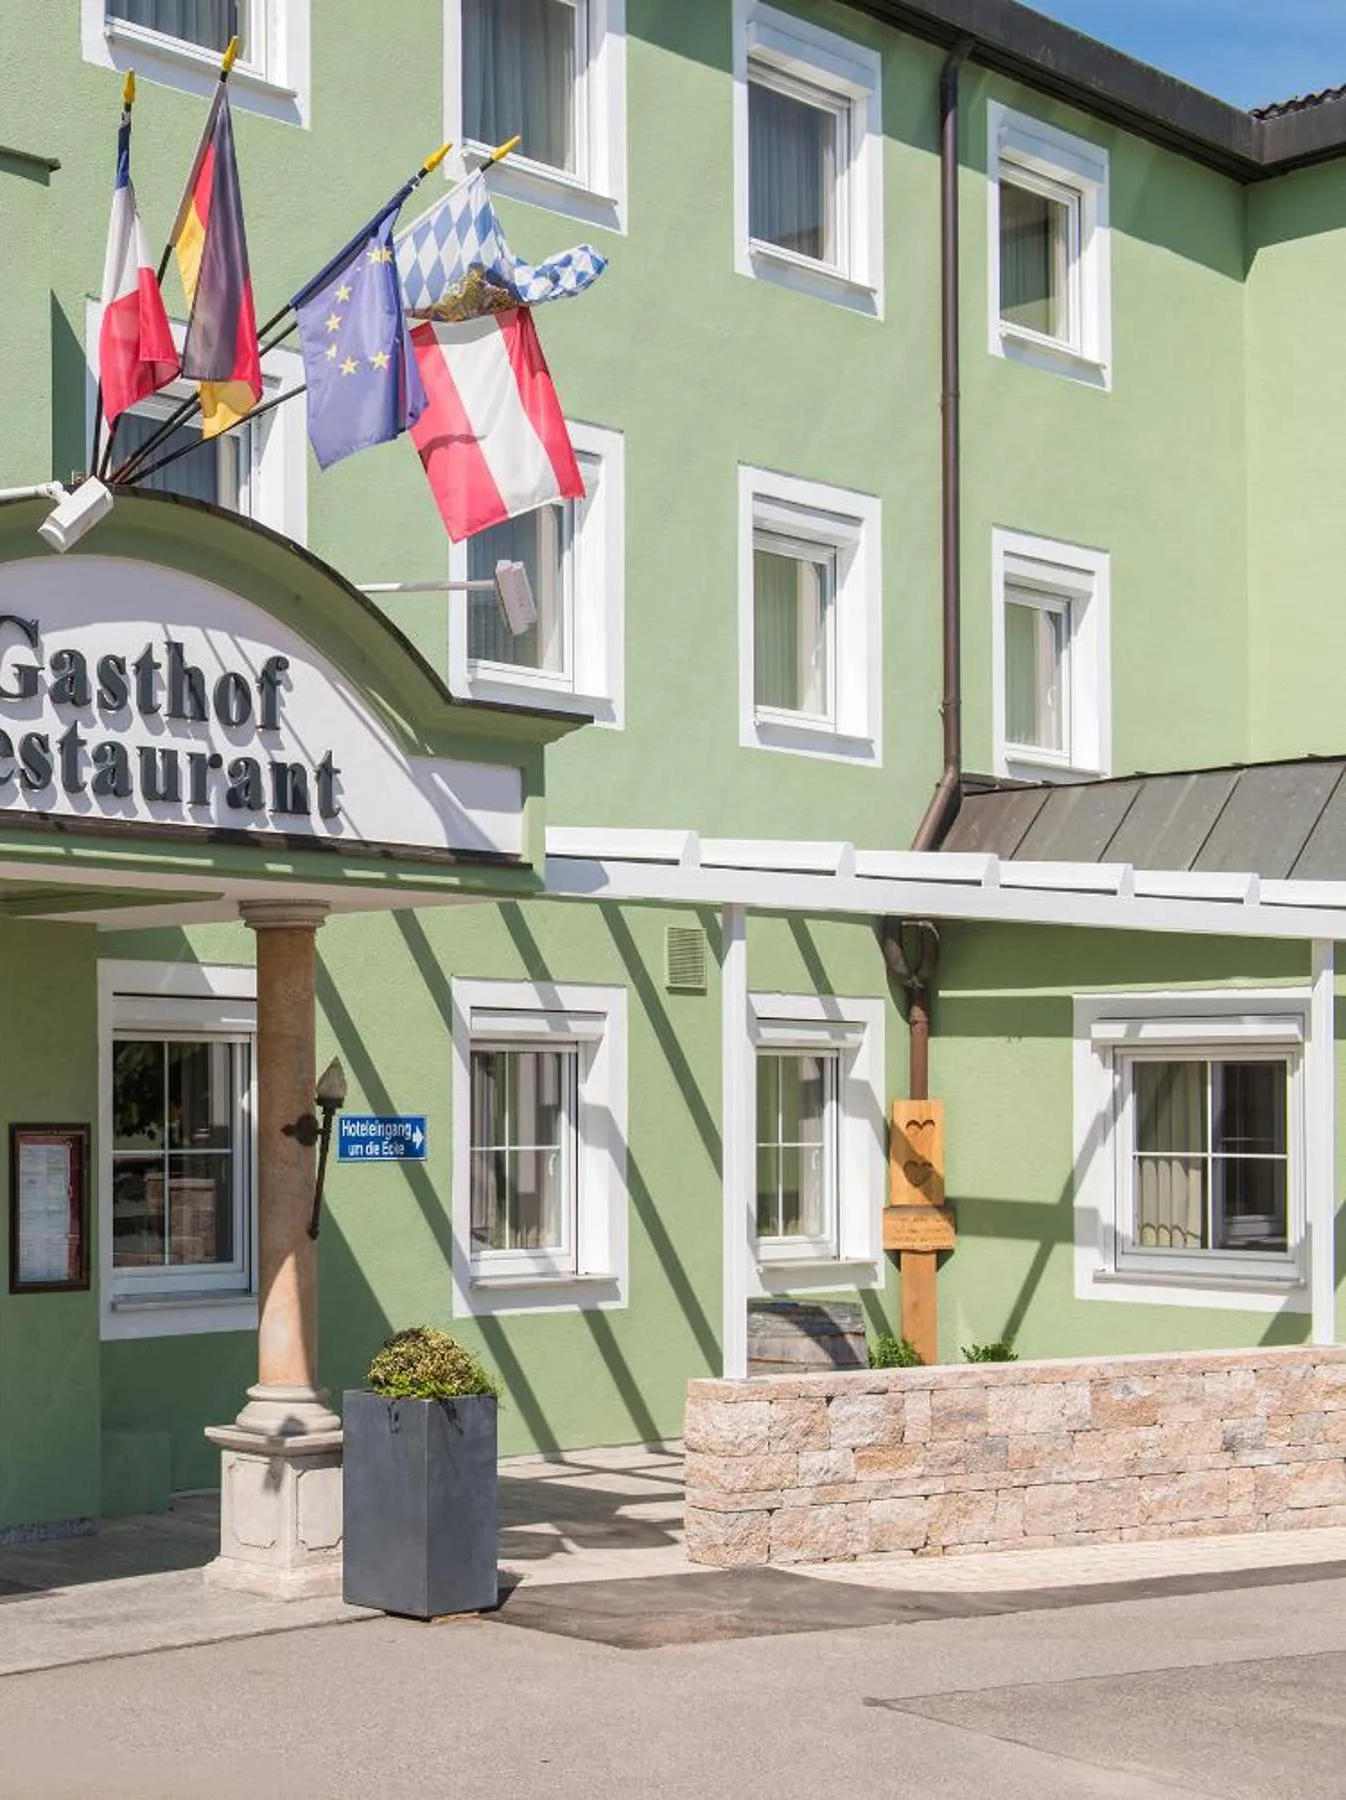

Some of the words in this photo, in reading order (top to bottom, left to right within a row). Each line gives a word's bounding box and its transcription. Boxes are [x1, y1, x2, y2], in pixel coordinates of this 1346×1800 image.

[342, 1119, 411, 1140] Hoteleingang
[348, 1143, 363, 1156] um
[381, 1141, 405, 1155] Ecke
